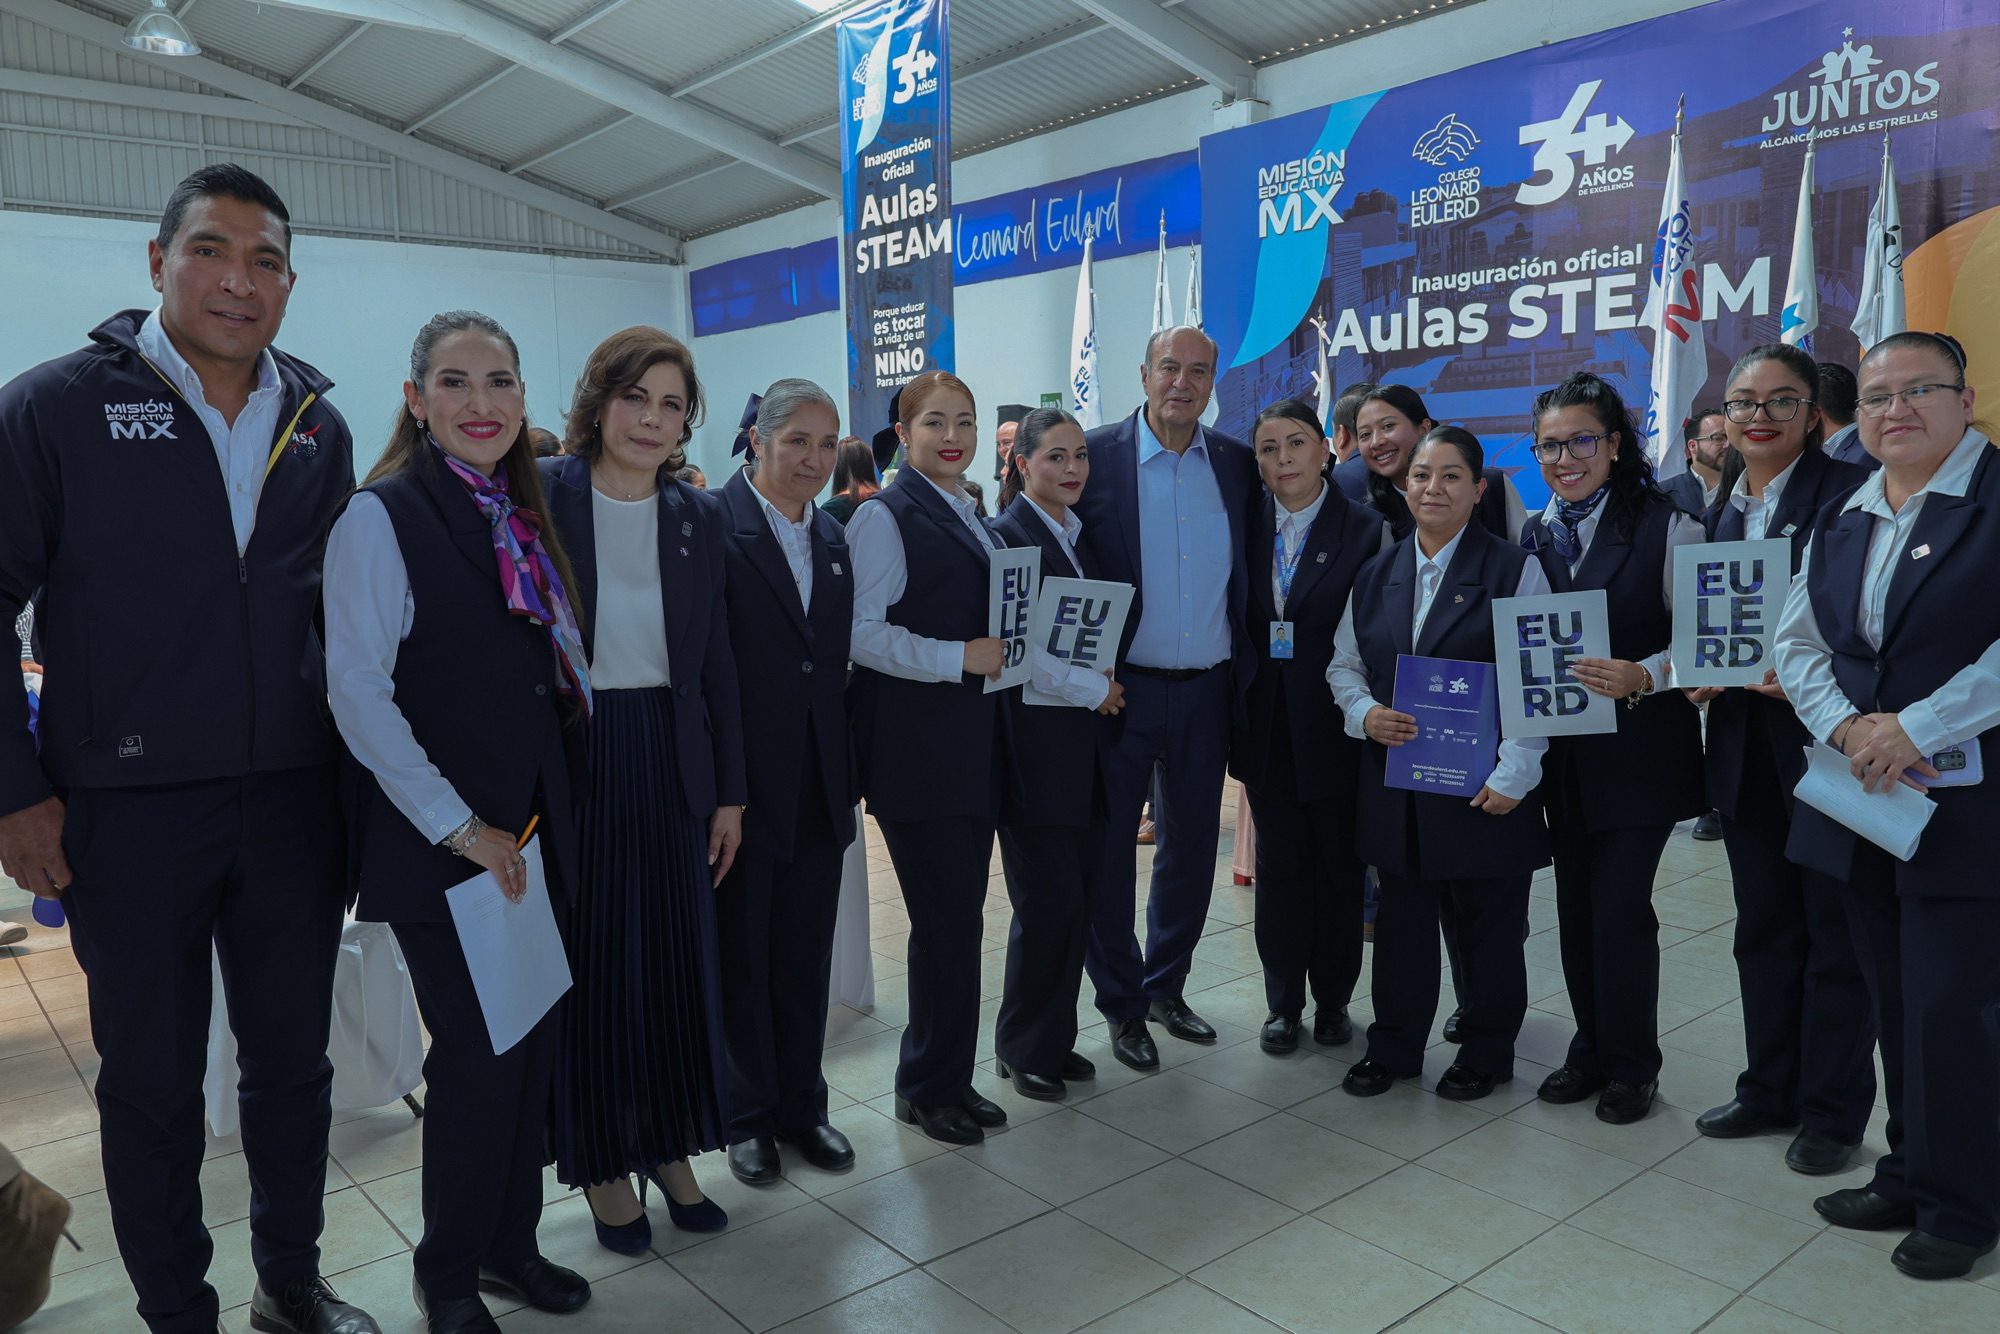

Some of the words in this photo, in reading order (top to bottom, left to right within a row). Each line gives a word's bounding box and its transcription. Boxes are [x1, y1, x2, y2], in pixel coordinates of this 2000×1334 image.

[917, 77, 937, 93] AÑOS
[1762, 61, 1941, 133] JUNTOS
[1843, 123, 1865, 135] LAS
[1869, 110, 1938, 130] ESTRELLAS
[864, 137, 932, 168] Inauguración
[1258, 149, 1346, 187] MISIÓN
[882, 160, 914, 181] Oficial
[1258, 171, 1345, 199] EDUCATIVA
[1438, 166, 1480, 184] COLEGIO
[1578, 165, 1634, 189] AÑOS
[1411, 178, 1480, 206] LEONARD
[1590, 181, 1634, 194] EXCELENCIA
[861, 183, 938, 230] Aulas
[1259, 183, 1345, 238] MX
[1411, 196, 1480, 228] EULERD
[856, 218, 952, 274] STEAM
[956, 198, 1037, 268] Leonard
[1412, 258, 1557, 294] Inauguración
[1565, 244, 1642, 272] oficial
[874, 307, 899, 319] Porque
[901, 302, 925, 314] educar
[1327, 298, 1489, 358] Aulas
[1508, 256, 1771, 341] STEM
[874, 321, 889, 335] es
[892, 314, 926, 332] tocar
[874, 337, 883, 346] La
[884, 333, 902, 345] vida
[903, 331, 914, 341] de
[916, 330, 925, 339] un
[875, 343, 924, 376] NIÑO
[876, 378, 893, 388] Para
[104, 398, 174, 414] MISIÓN
[106, 413, 175, 421] EDUCATIVA
[110, 421, 178, 439] MX
[292, 431, 318, 447] ASA
[1003, 566, 1031, 602] EU
[1697, 559, 1764, 596] EU
[1000, 600, 1029, 639] LE
[1054, 596, 1112, 628] EU
[1697, 596, 1764, 636] LE
[1047, 625, 1103, 661] LE
[1517, 611, 1583, 648] EU
[1519, 645, 1584, 686] LE
[1695, 637, 1764, 668] RD
[1522, 685, 1589, 717] RD
